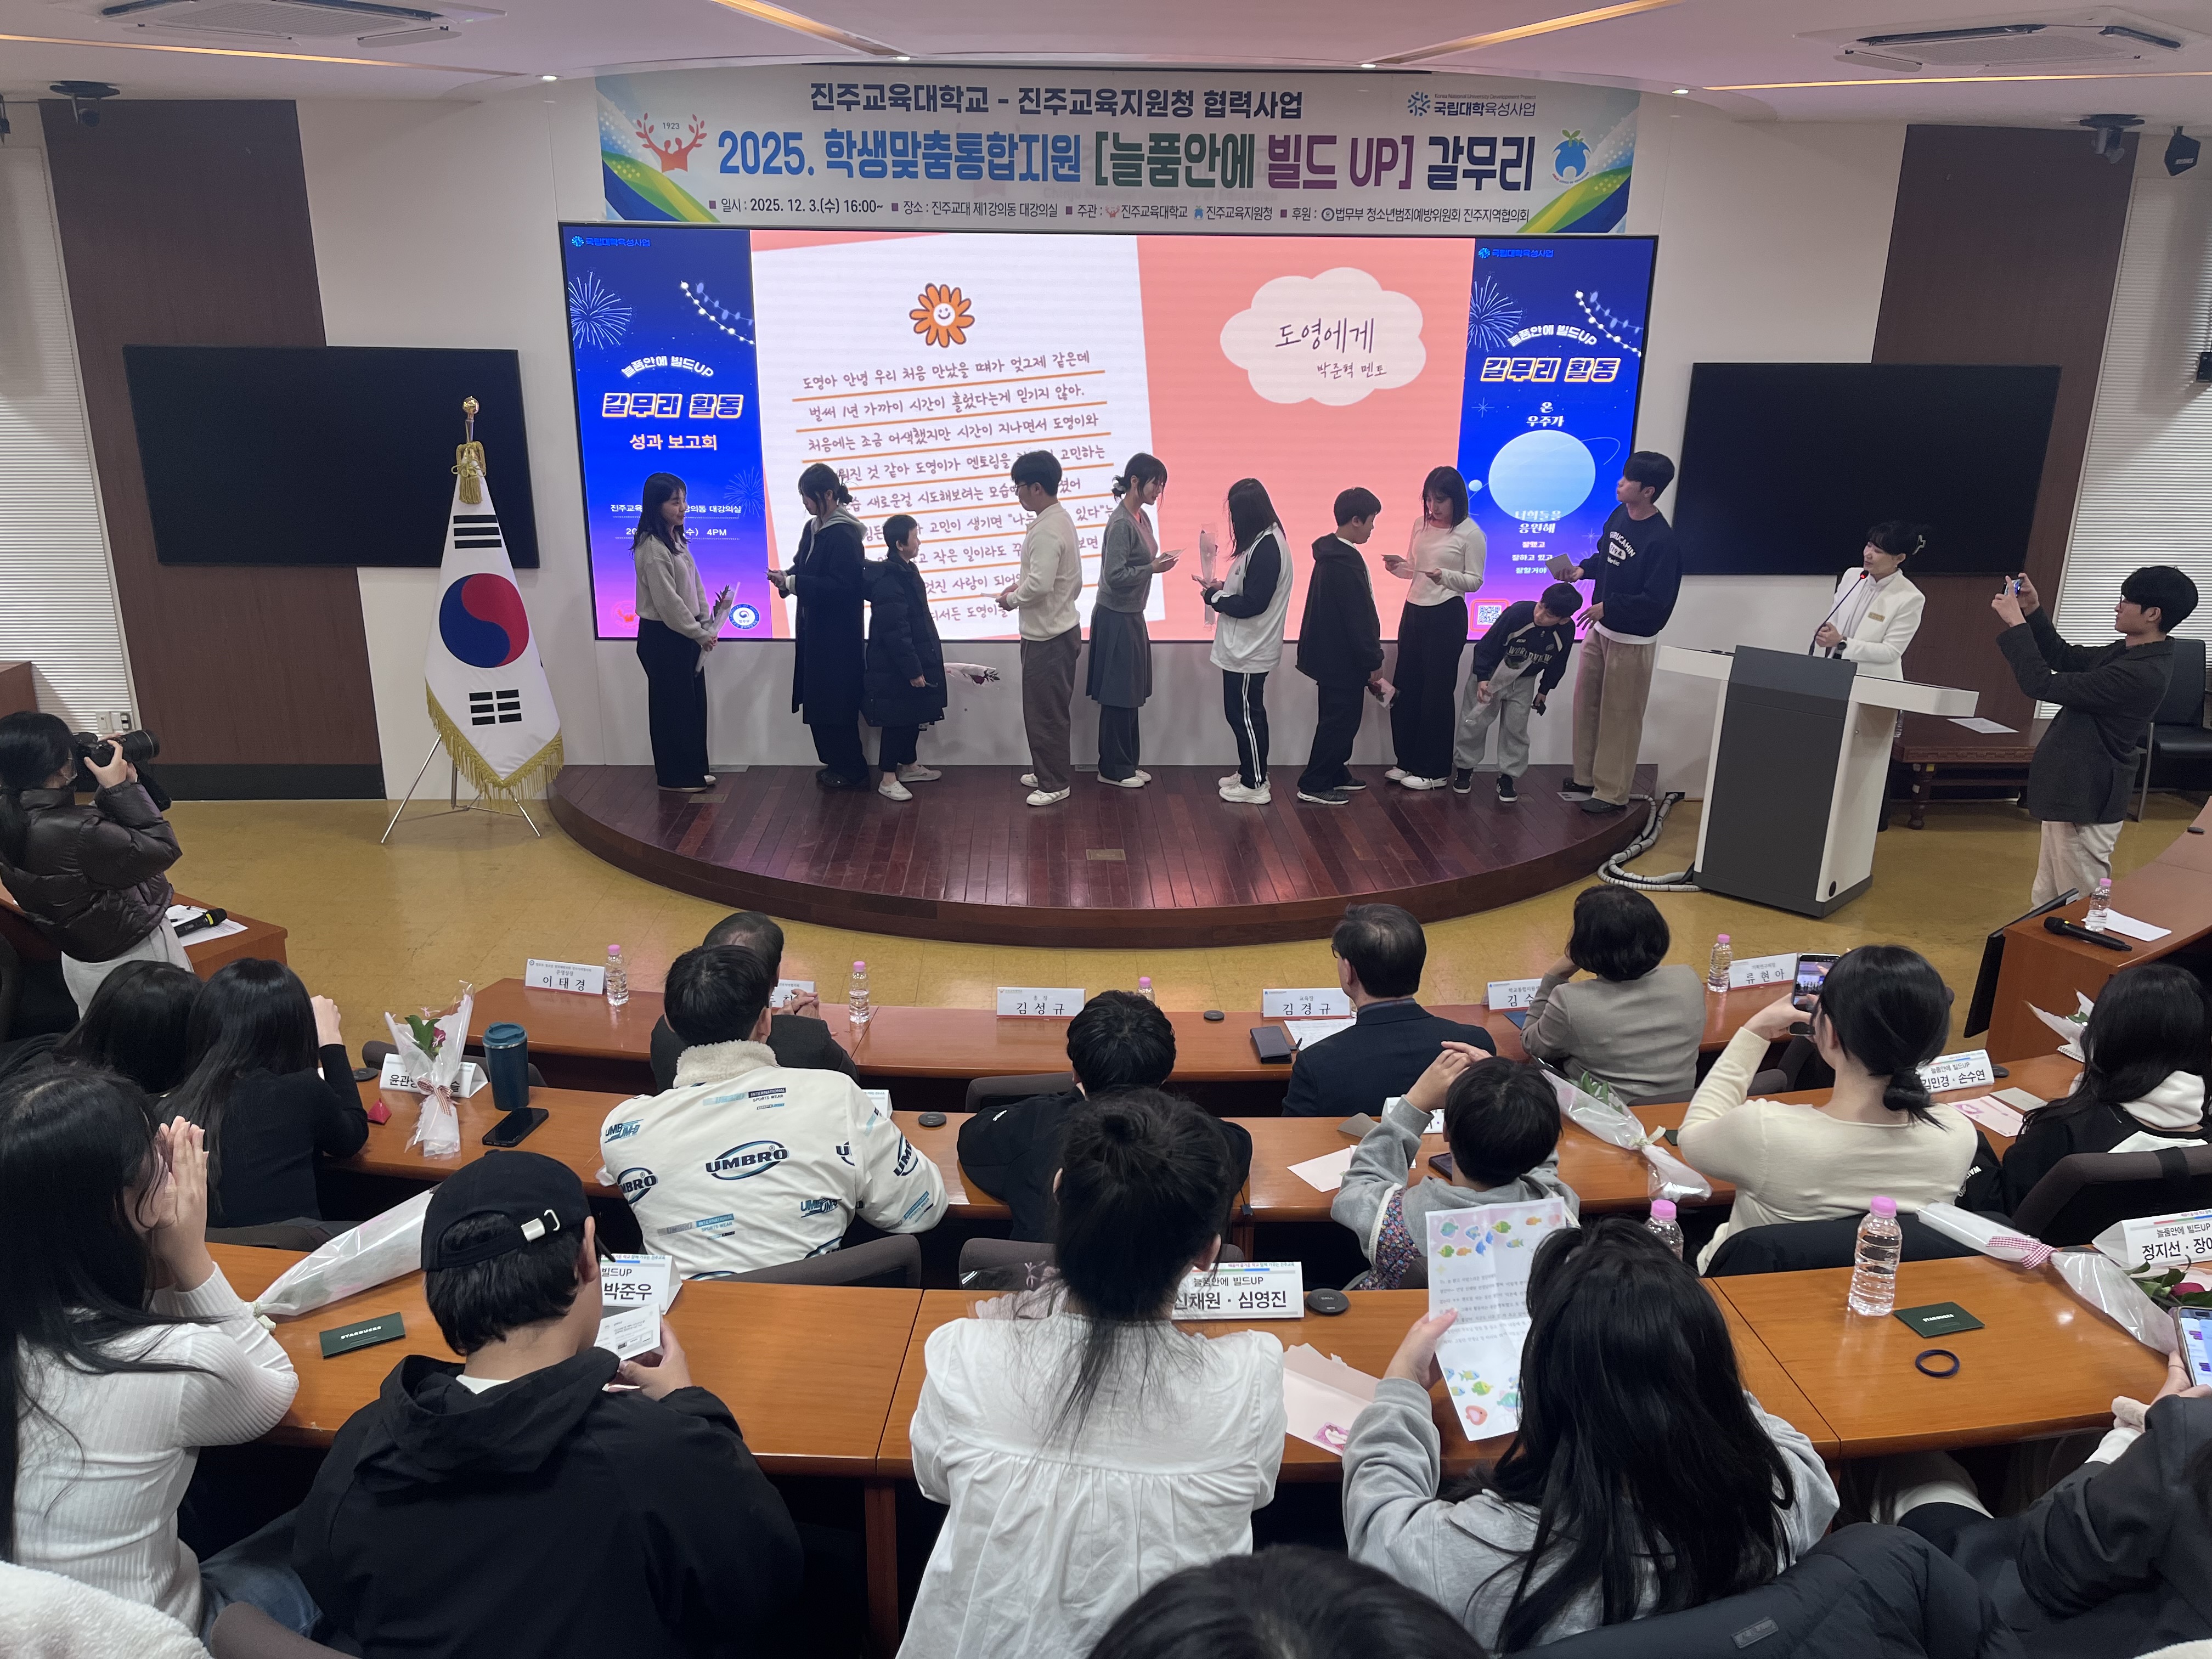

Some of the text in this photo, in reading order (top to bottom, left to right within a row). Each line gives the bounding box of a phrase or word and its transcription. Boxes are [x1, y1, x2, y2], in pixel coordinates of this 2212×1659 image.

[810, 82, 989, 115] 진주교육대학교
[1018, 87, 1193, 119] 진주교육지원청
[1203, 89, 1304, 120] 협력사업
[1434, 101, 1536, 116] 국립대학육성사업
[718, 128, 1536, 191] 2025. 학생맞춤통합지원 [늘품안에 빌드 UP] 갈무리
[750, 198, 783, 212] 2025.
[788, 199, 805, 212] 12.
[809, 198, 840, 214] 3.(수)
[844, 199, 884, 213] 16:00~
[932, 201, 971, 216] 진주교대
[973, 201, 1017, 217] 제1강의동
[1020, 202, 1058, 218] 대강의실
[1121, 204, 1188, 219] 진주교육대학교
[1206, 205, 1273, 221] 진주교육지원청
[1335, 207, 1364, 221] 법무부
[1367, 207, 1460, 223] 청소년범죄예방위원회
[1463, 208, 1530, 223] 진주지역협의회
[585, 237, 651, 247] 국립대학육성사업
[1492, 249, 1554, 258] 국립대학육성사업
[1275, 317, 1374, 354] 도영에게
[1508, 324, 1598, 347] 늘품안에 빌드UP
[621, 356, 714, 378] 늘품안에 빌드UP
[803, 374, 838, 390] 도영아
[843, 370, 868, 387] 안녕
[874, 369, 897, 385] 우리
[902, 365, 926, 381] 처음
[932, 362, 969, 379] 만났을
[1011, 354, 1046, 373] 엊그제
[1052, 350, 1090, 369] 같은데
[1317, 362, 1387, 380] 박준혁 멘토
[1481, 357, 1621, 383] 갈무리 활동
[602, 392, 744, 419] 갈무리 활동
[809, 405, 837, 422] 벌써
[864, 399, 904, 416] 가까이
[910, 396, 946, 411] 시간이
[952, 389, 1011, 414] 흘렀다는게
[1017, 387, 1049, 403] 믿기지
[1540, 401, 1554, 414] 온
[1526, 415, 1565, 427] 우주가
[629, 433, 718, 451] 성과 보고회
[808, 413, 1099, 453] 처음에는 조금 어색했지만 시간이 지나면서 도영이와
[867, 466, 881, 480] 것
[884, 462, 910, 479] 같아
[916, 457, 961, 475] 도영이가
[966, 453, 1011, 470] 멘토링을
[1060, 445, 1105, 460] 고민하는
[867, 492, 913, 509] 새로운걸
[917, 487, 984, 503] 시도해보려는
[709, 505, 742, 514] 대강의실
[1515, 510, 1562, 521] 너희들을
[930, 519, 961, 533] 고민이
[967, 515, 1003, 529] 생기면
[1518, 523, 1556, 534] 응원해
[934, 549, 958, 564] 작은
[963, 545, 1007, 562] 일이라도
[1958, 1069, 1986, 1084] 손수연
[751, 1088, 786, 1097] INTERNATIONAL
[706, 1149, 789, 1172] UMBRO
[698, 1214, 734, 1226] INTERNATIONAL
[2157, 1223, 2210, 1238] 늘품안에 빌드UP
[2142, 1240, 2181, 1261] 정지선
[601, 1267, 632, 1277] 빌드UP
[1233, 1277, 1263, 1286] 빌드UP
[604, 1282, 652, 1301] 박준우
[1238, 1290, 1286, 1309] 심영진
